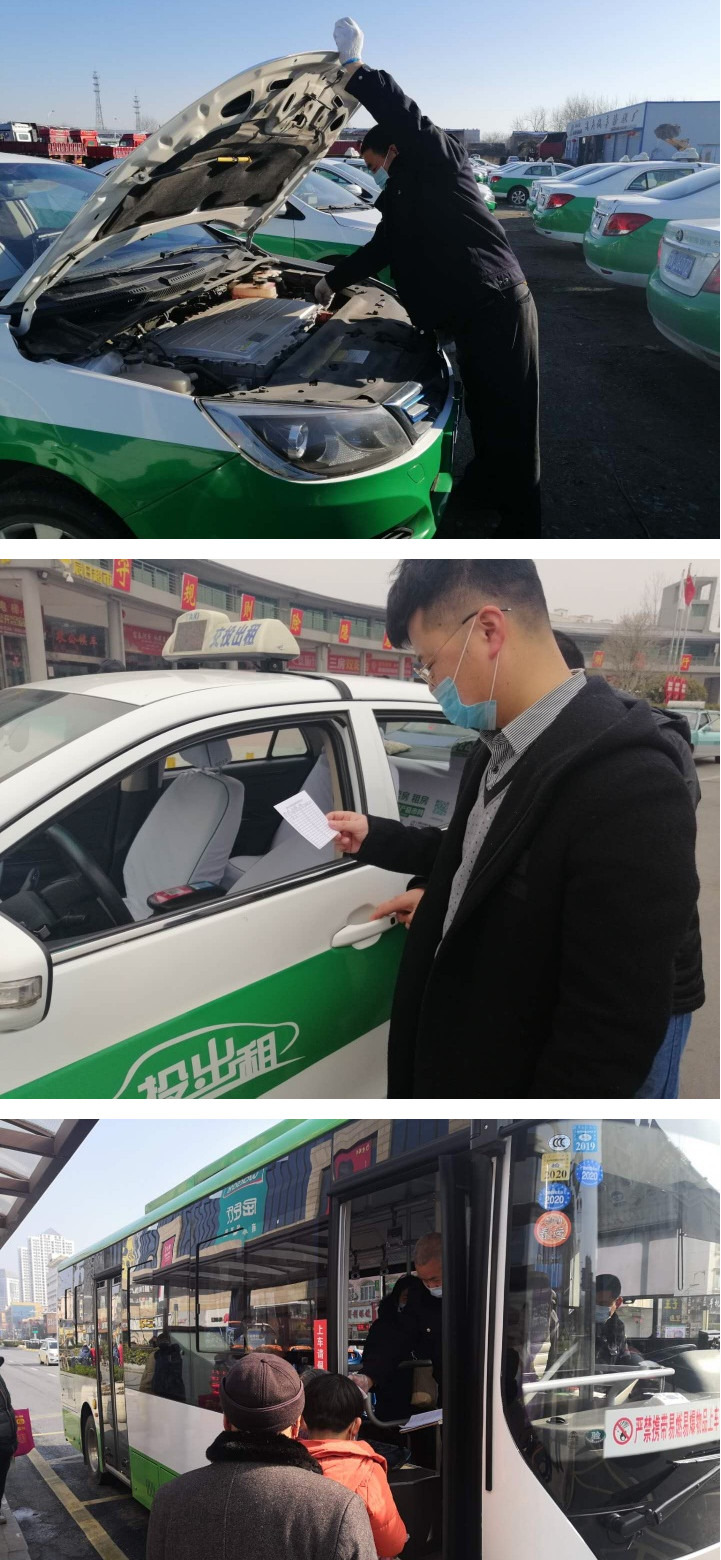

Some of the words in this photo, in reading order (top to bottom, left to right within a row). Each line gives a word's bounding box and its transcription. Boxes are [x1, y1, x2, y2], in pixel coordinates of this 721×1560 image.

[183, 579, 196, 607] 规
[575, 1141, 596, 1151] 2019
[544, 1170, 567, 1180] 2020
[581, 1171, 598, 1181] 2020
[545, 1195, 564, 1204] 2020
